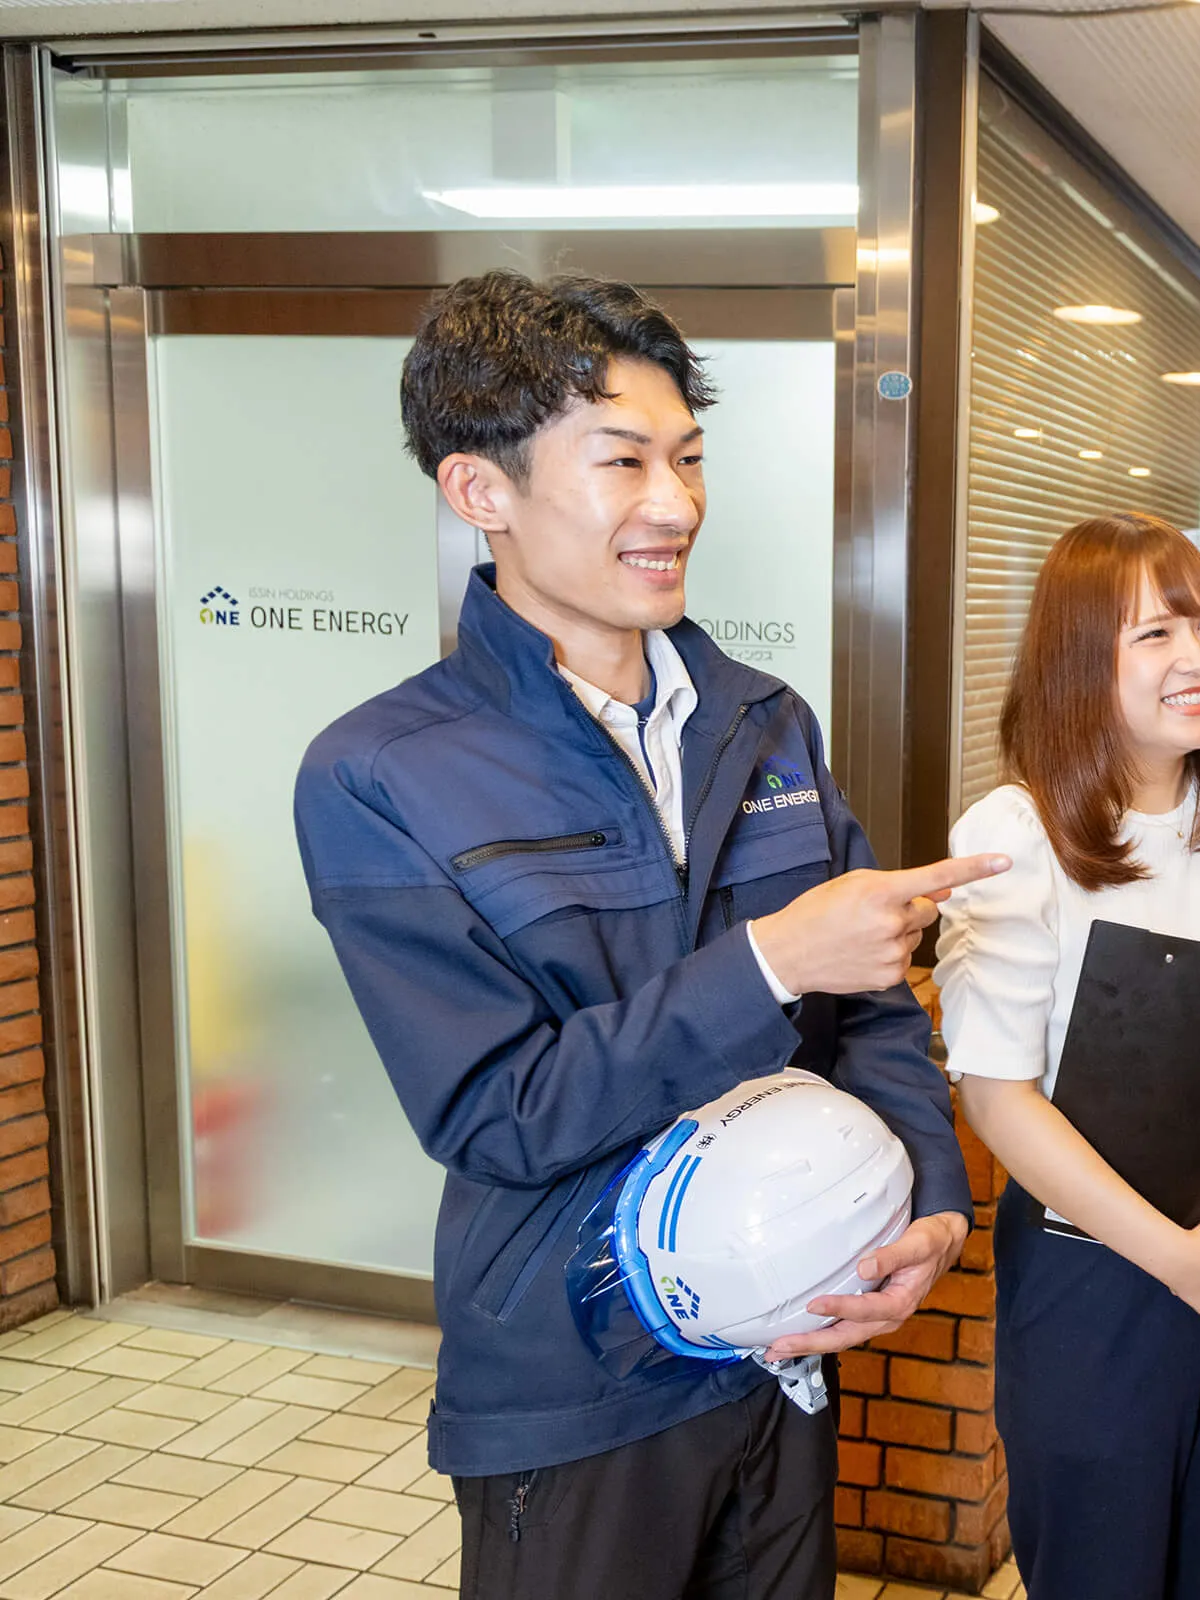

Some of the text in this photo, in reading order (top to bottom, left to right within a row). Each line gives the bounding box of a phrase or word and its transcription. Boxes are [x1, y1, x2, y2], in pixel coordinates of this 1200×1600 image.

[248, 587, 335, 602] ISSIN HOLDINGS
[250, 606, 409, 636] ONE ENERGY
[697, 618, 795, 643] OLDINGS
[742, 797, 774, 814] ONE
[720, 1086, 783, 1128] ENERGY
